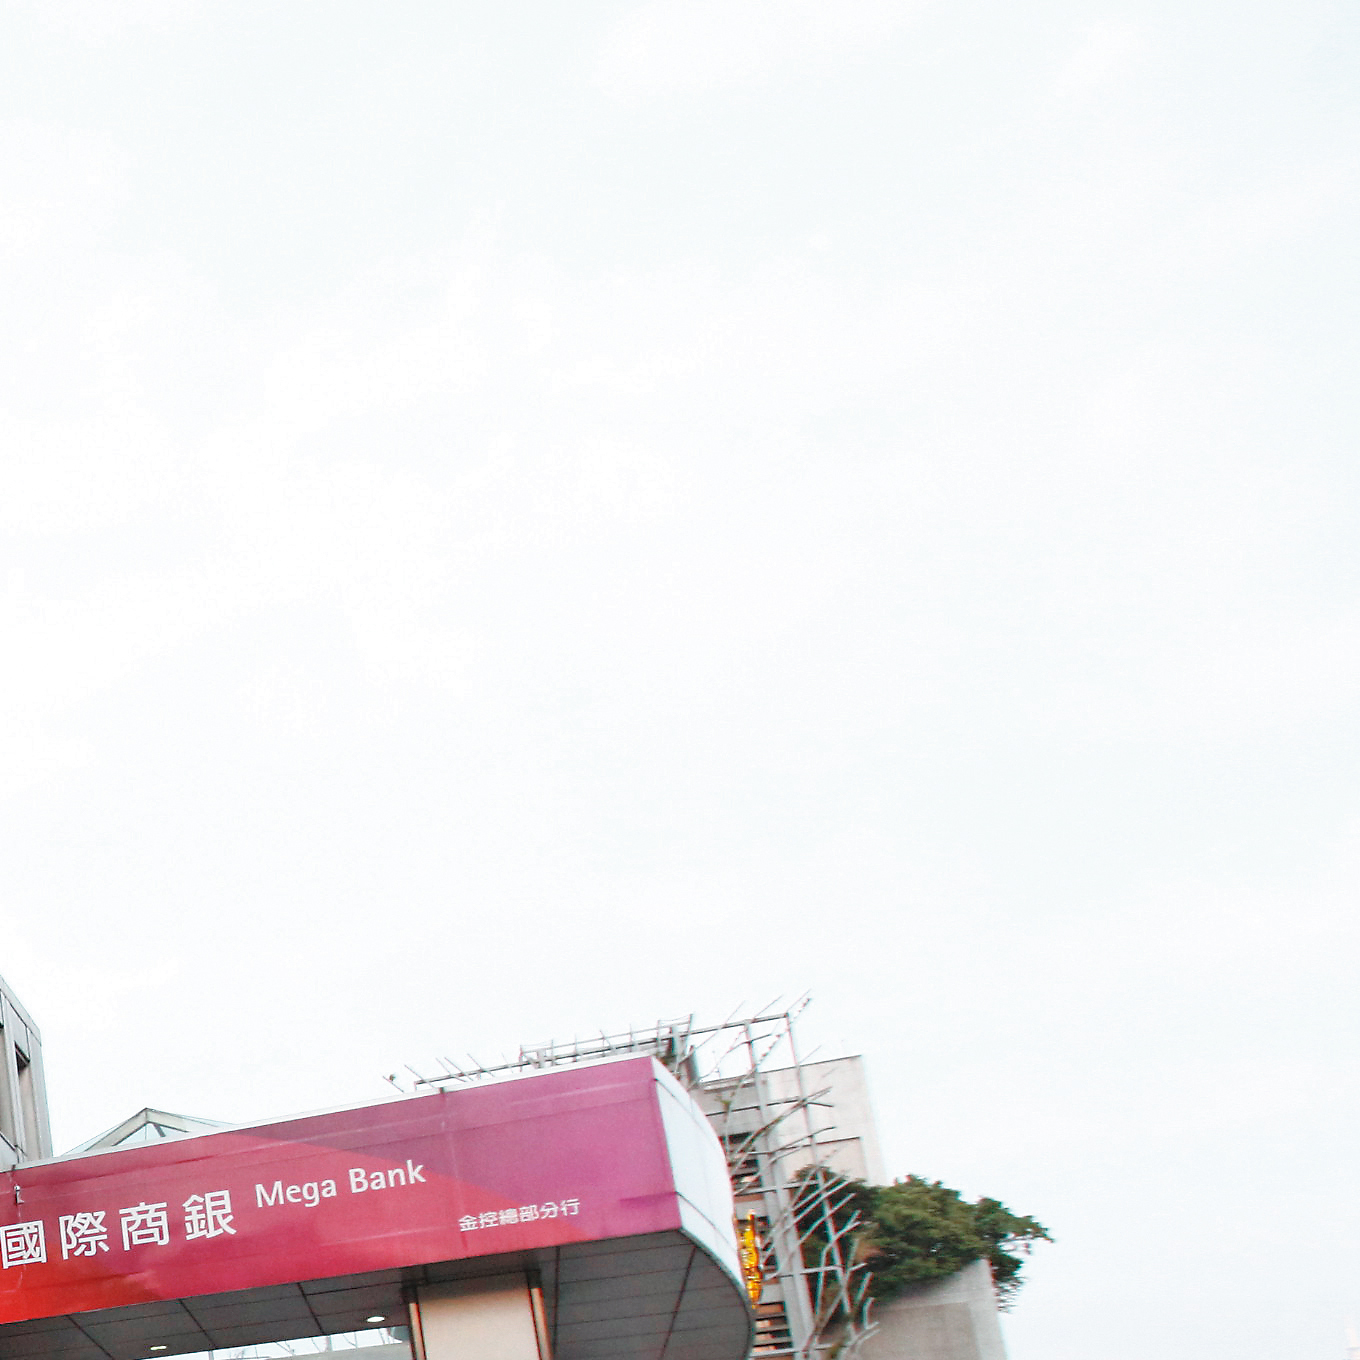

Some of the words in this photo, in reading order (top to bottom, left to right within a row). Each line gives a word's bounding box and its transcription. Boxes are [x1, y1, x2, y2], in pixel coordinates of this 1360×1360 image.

[255, 1180, 338, 1208] Mega
[348, 1159, 427, 1194] Bank
[458, 1198, 581, 1232] 金控總部分行
